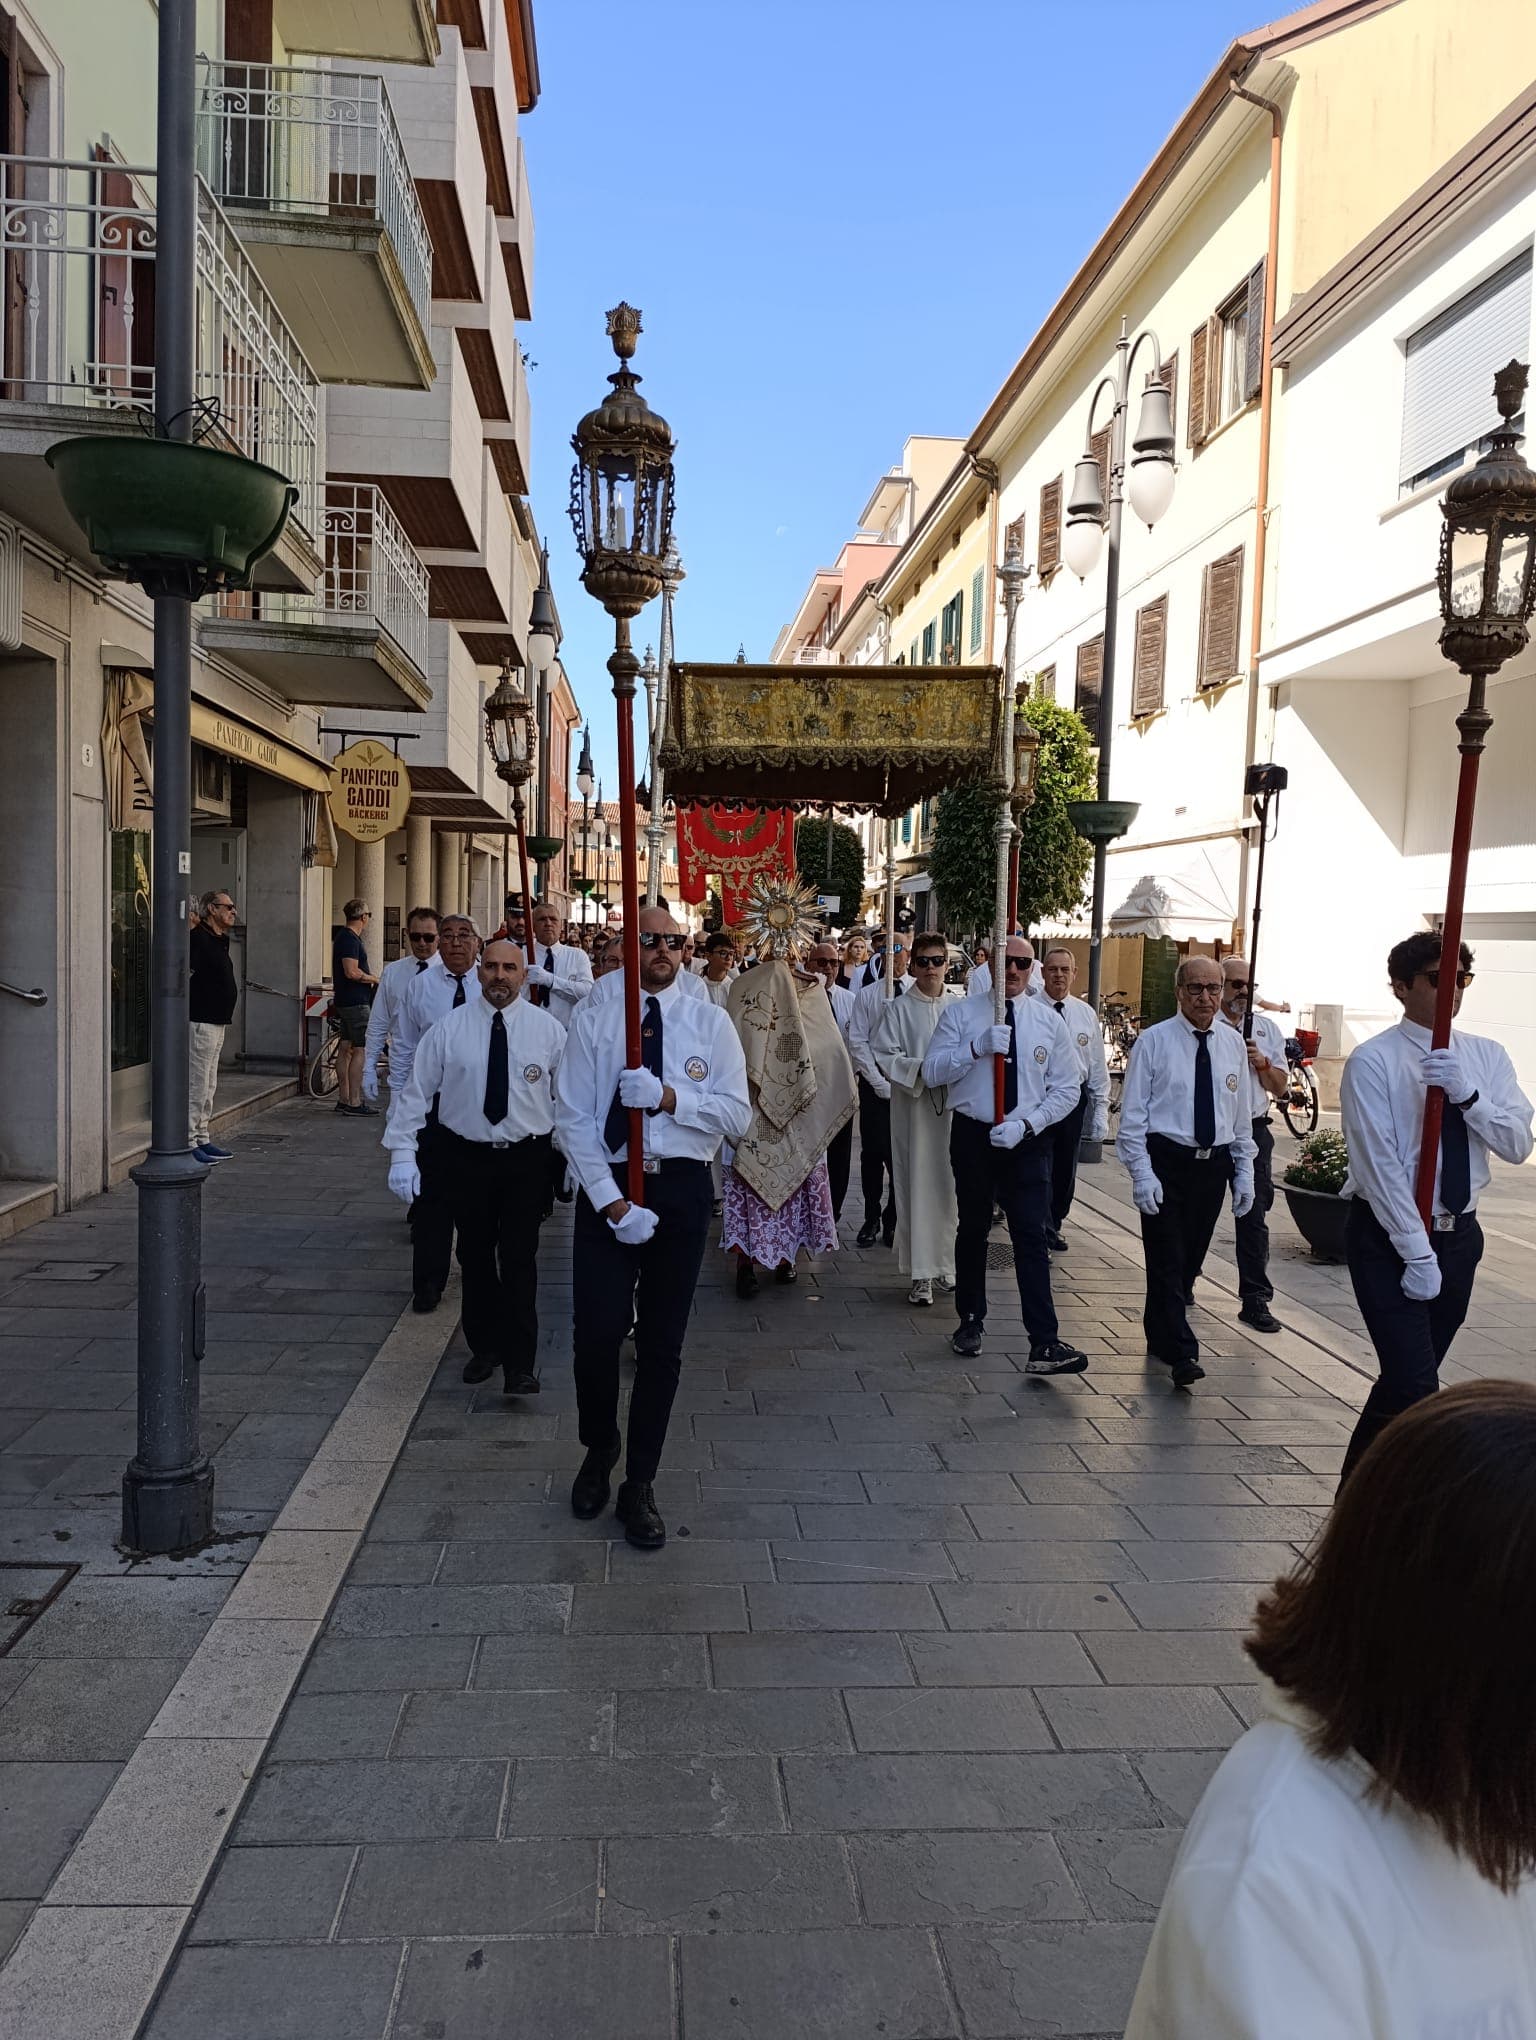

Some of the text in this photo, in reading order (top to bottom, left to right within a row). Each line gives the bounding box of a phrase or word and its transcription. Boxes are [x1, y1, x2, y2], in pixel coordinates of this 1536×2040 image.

[216, 720, 253, 755] PANIFICIO
[341, 767, 399, 787] PANIFICIO
[347, 787, 391, 808] GADDI
[348, 808, 389, 820] BÄCKEREI
